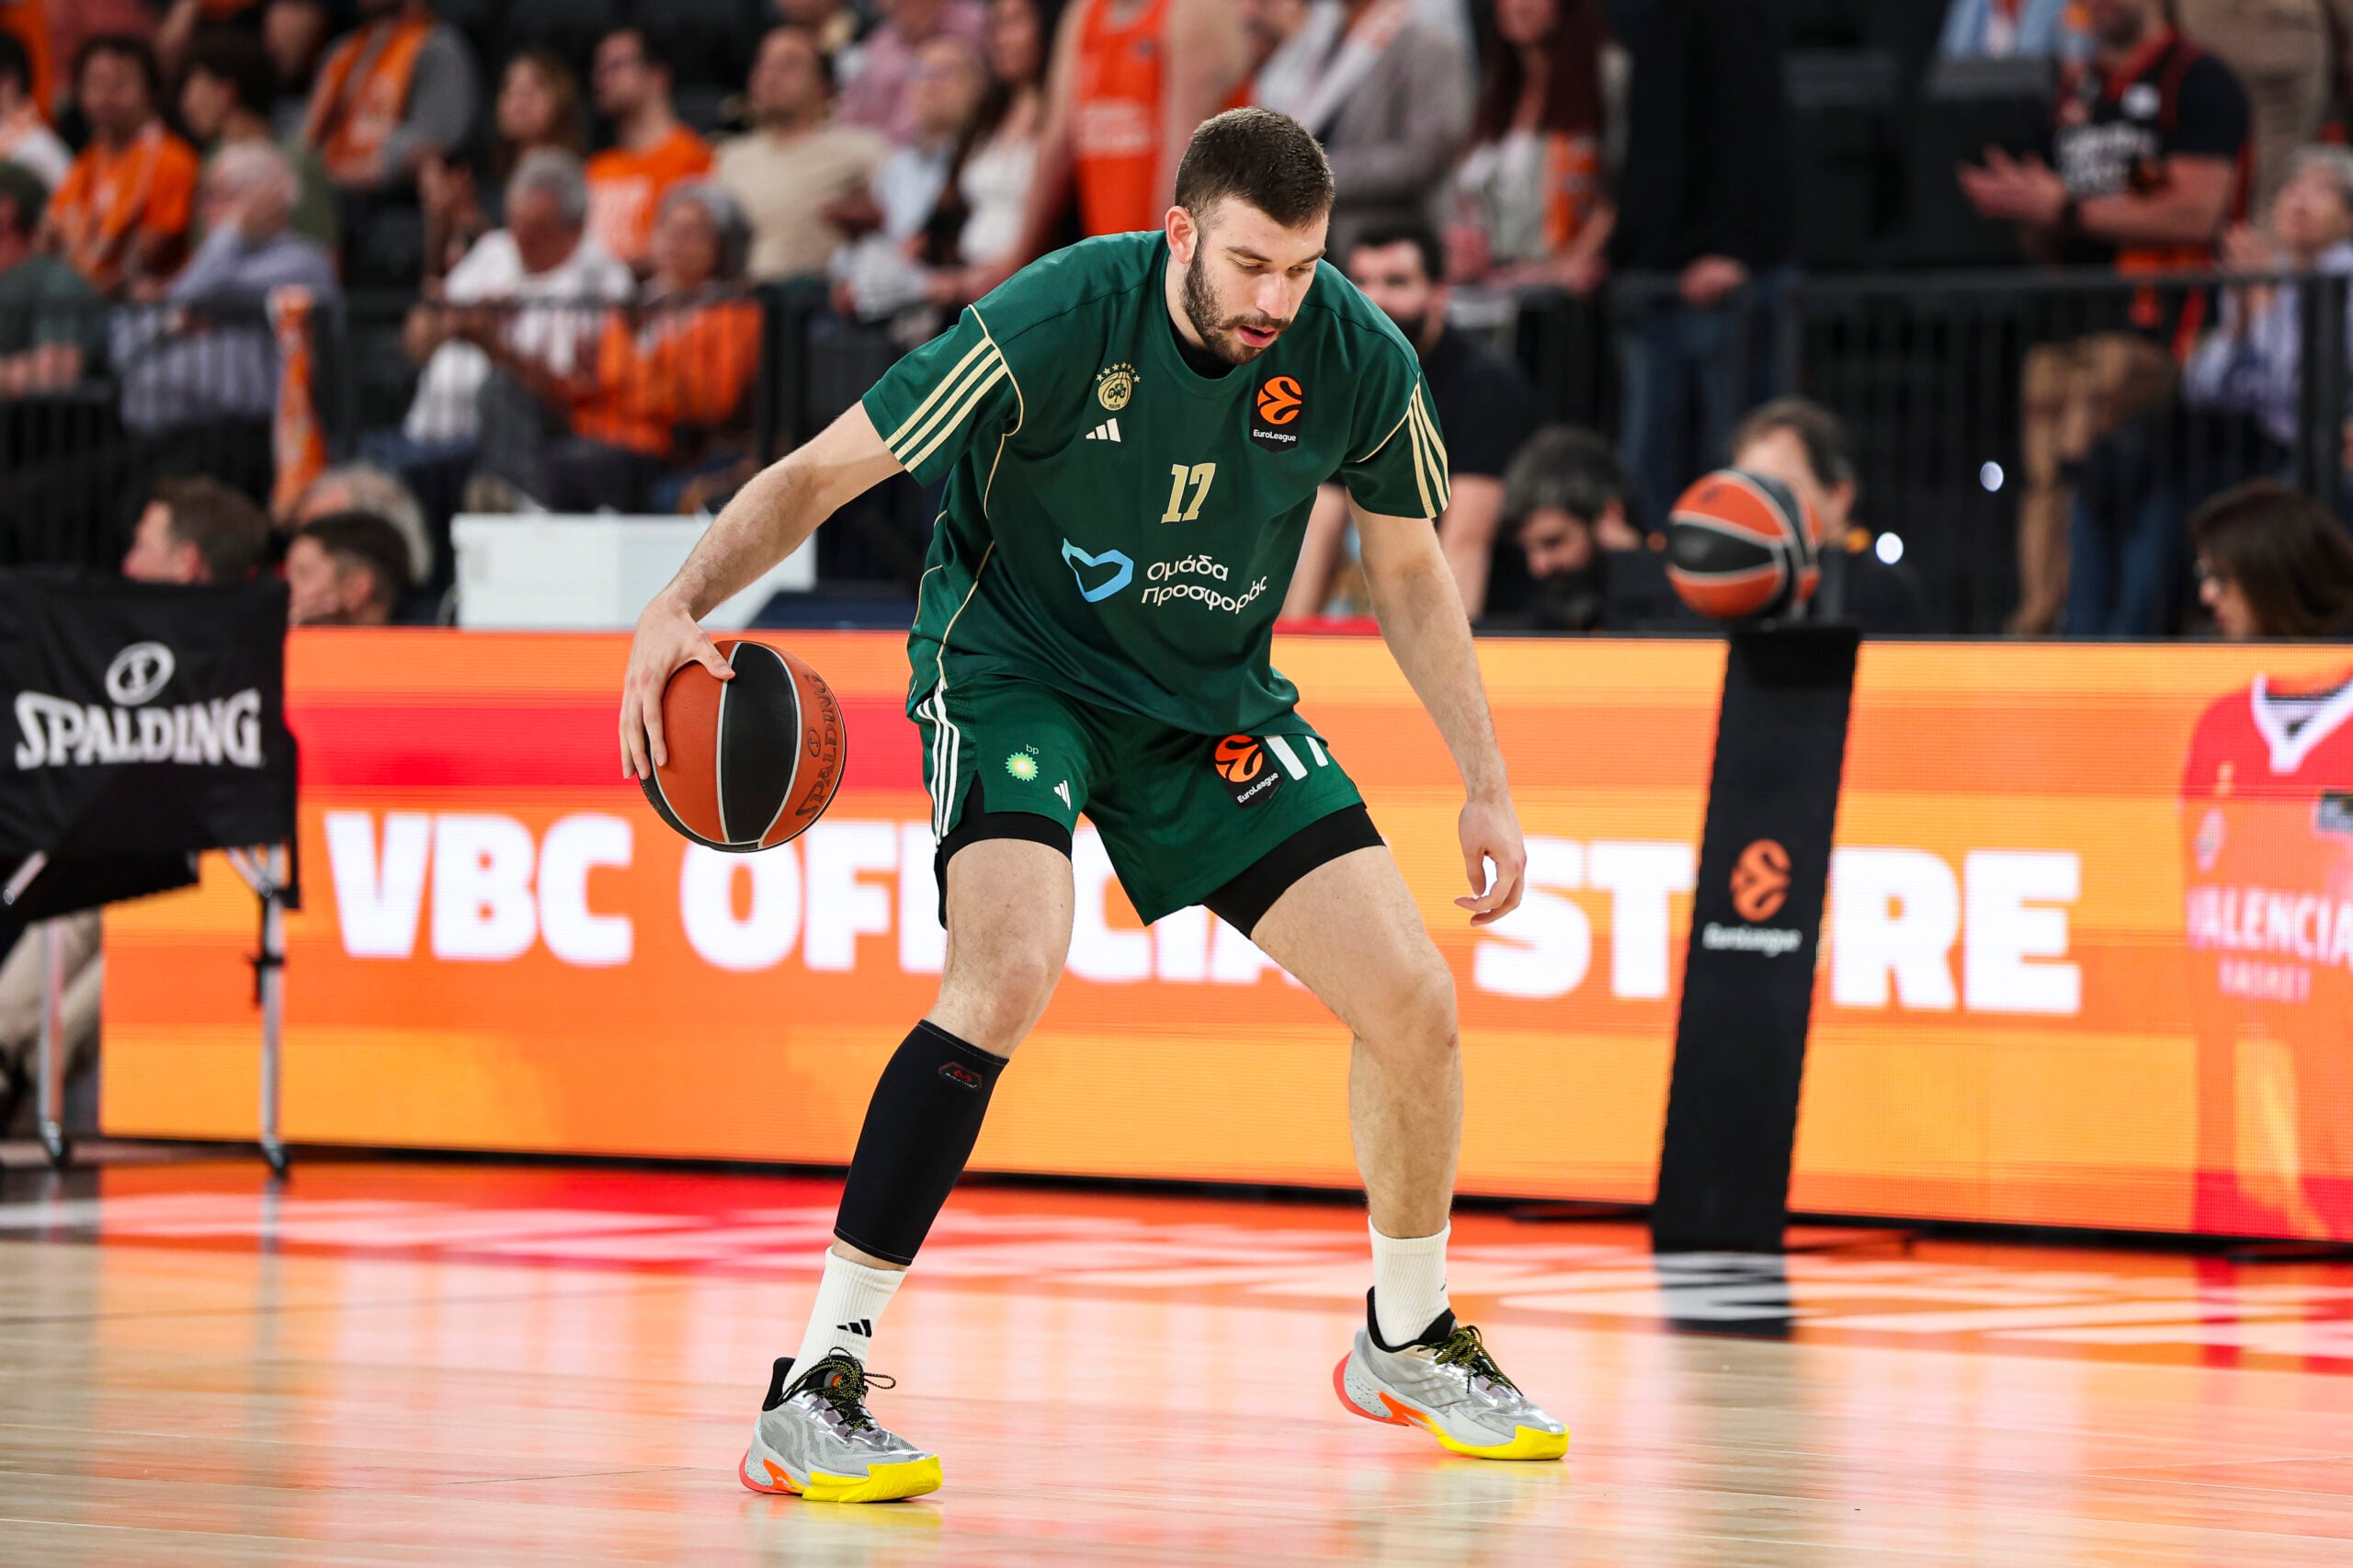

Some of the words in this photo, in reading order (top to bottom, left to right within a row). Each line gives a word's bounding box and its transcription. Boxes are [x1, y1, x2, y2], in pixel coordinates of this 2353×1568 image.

[1253, 428, 1297, 442] EuroLeague
[1161, 462, 1216, 523] 17
[15, 688, 261, 770] SPALDING
[794, 674, 837, 820] SPALDING
[1026, 743, 1040, 755] bp
[1236, 772, 1279, 803] EuroLeague
[324, 811, 634, 969] VBC
[680, 820, 1307, 985] OFCI
[1472, 835, 2081, 1014] STRE
